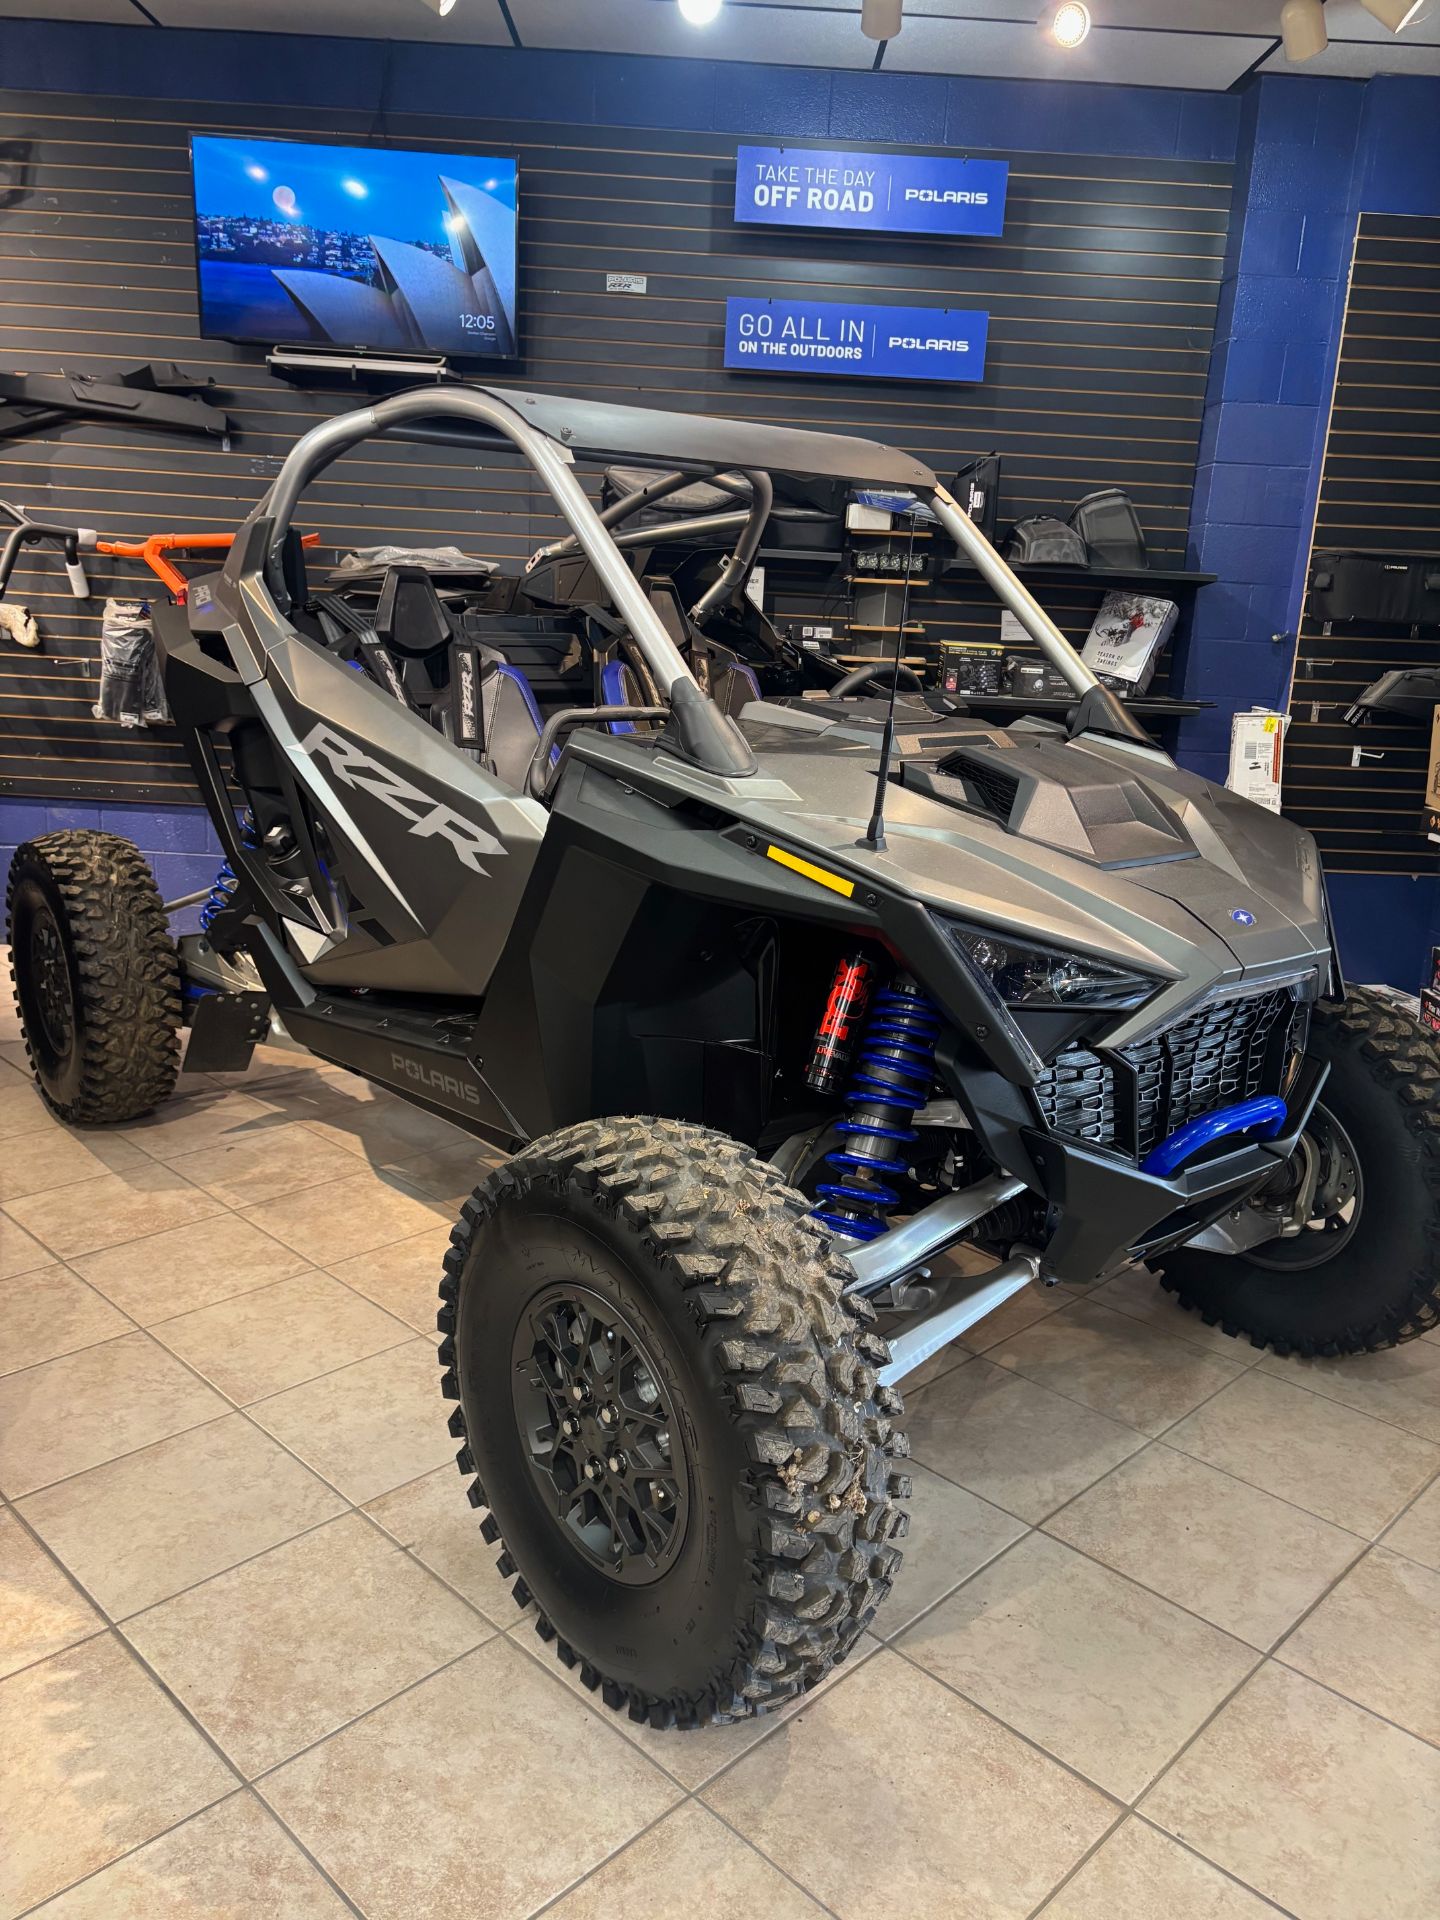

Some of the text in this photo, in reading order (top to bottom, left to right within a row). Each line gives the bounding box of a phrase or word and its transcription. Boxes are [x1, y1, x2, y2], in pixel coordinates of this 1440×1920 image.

[756, 164, 875, 187] TAKE THE DAY
[754, 184, 874, 212] OFF ROAD
[905, 188, 989, 205] POLARIS
[459, 314, 495, 330] 12:05
[739, 313, 865, 343] GO ALL IN
[738, 340, 863, 360] ON THE OUTDOORS
[888, 336, 969, 352] POLARIS
[192, 585, 212, 606] PRO
[1097, 650, 1115, 660] SEASON
[461, 670, 475, 718] RZR
[300, 722, 509, 878] RZR
[819, 958, 868, 1040] FOX
[391, 1052, 480, 1105] POLARIS
